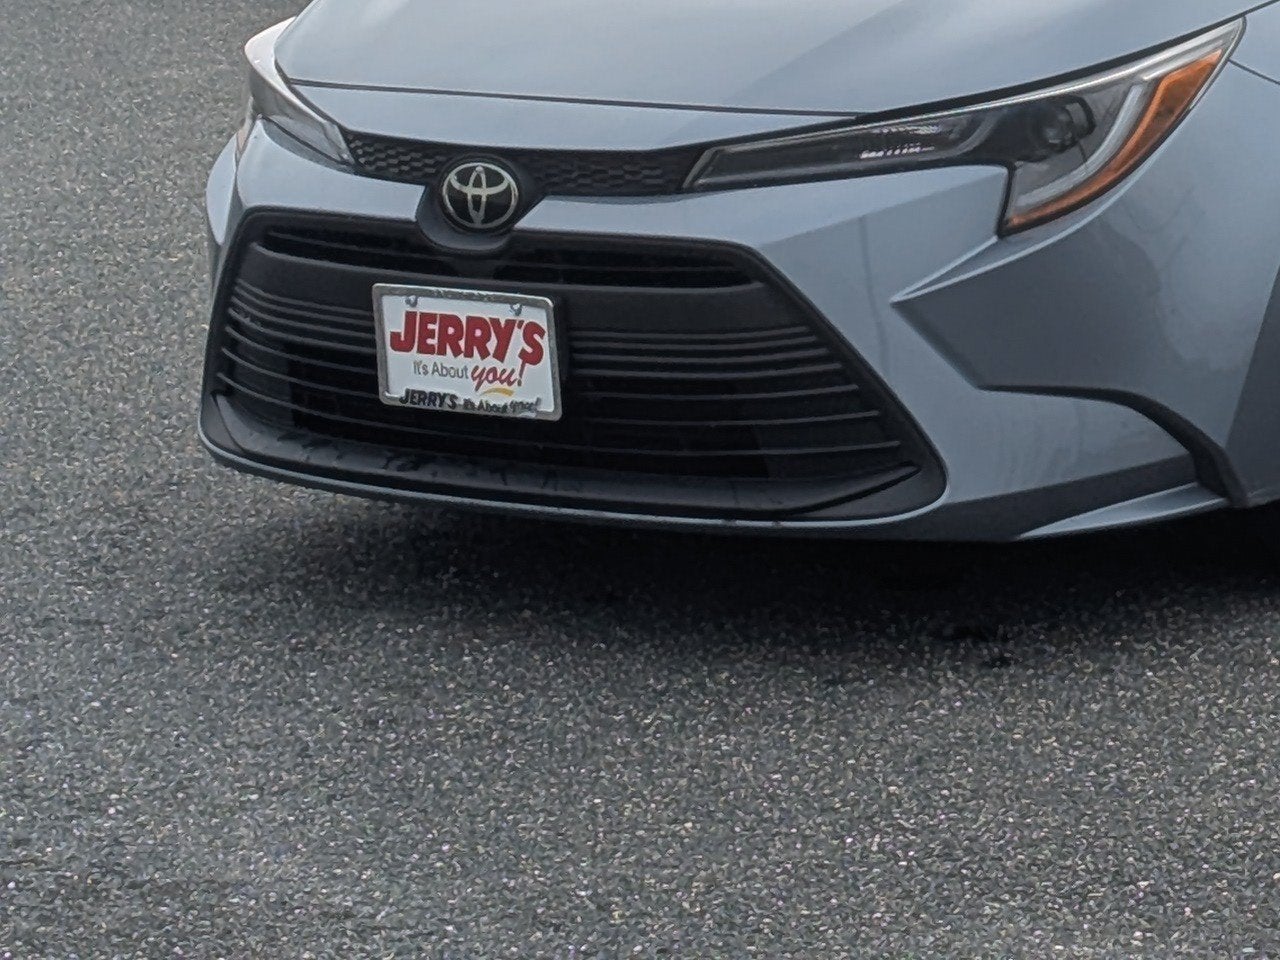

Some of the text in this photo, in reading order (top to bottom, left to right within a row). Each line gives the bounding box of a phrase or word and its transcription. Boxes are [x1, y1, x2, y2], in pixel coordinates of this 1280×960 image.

[390, 311, 546, 366] JERRY'S
[413, 360, 526, 392] It's About you!
[399, 388, 459, 410] JERRY'S
